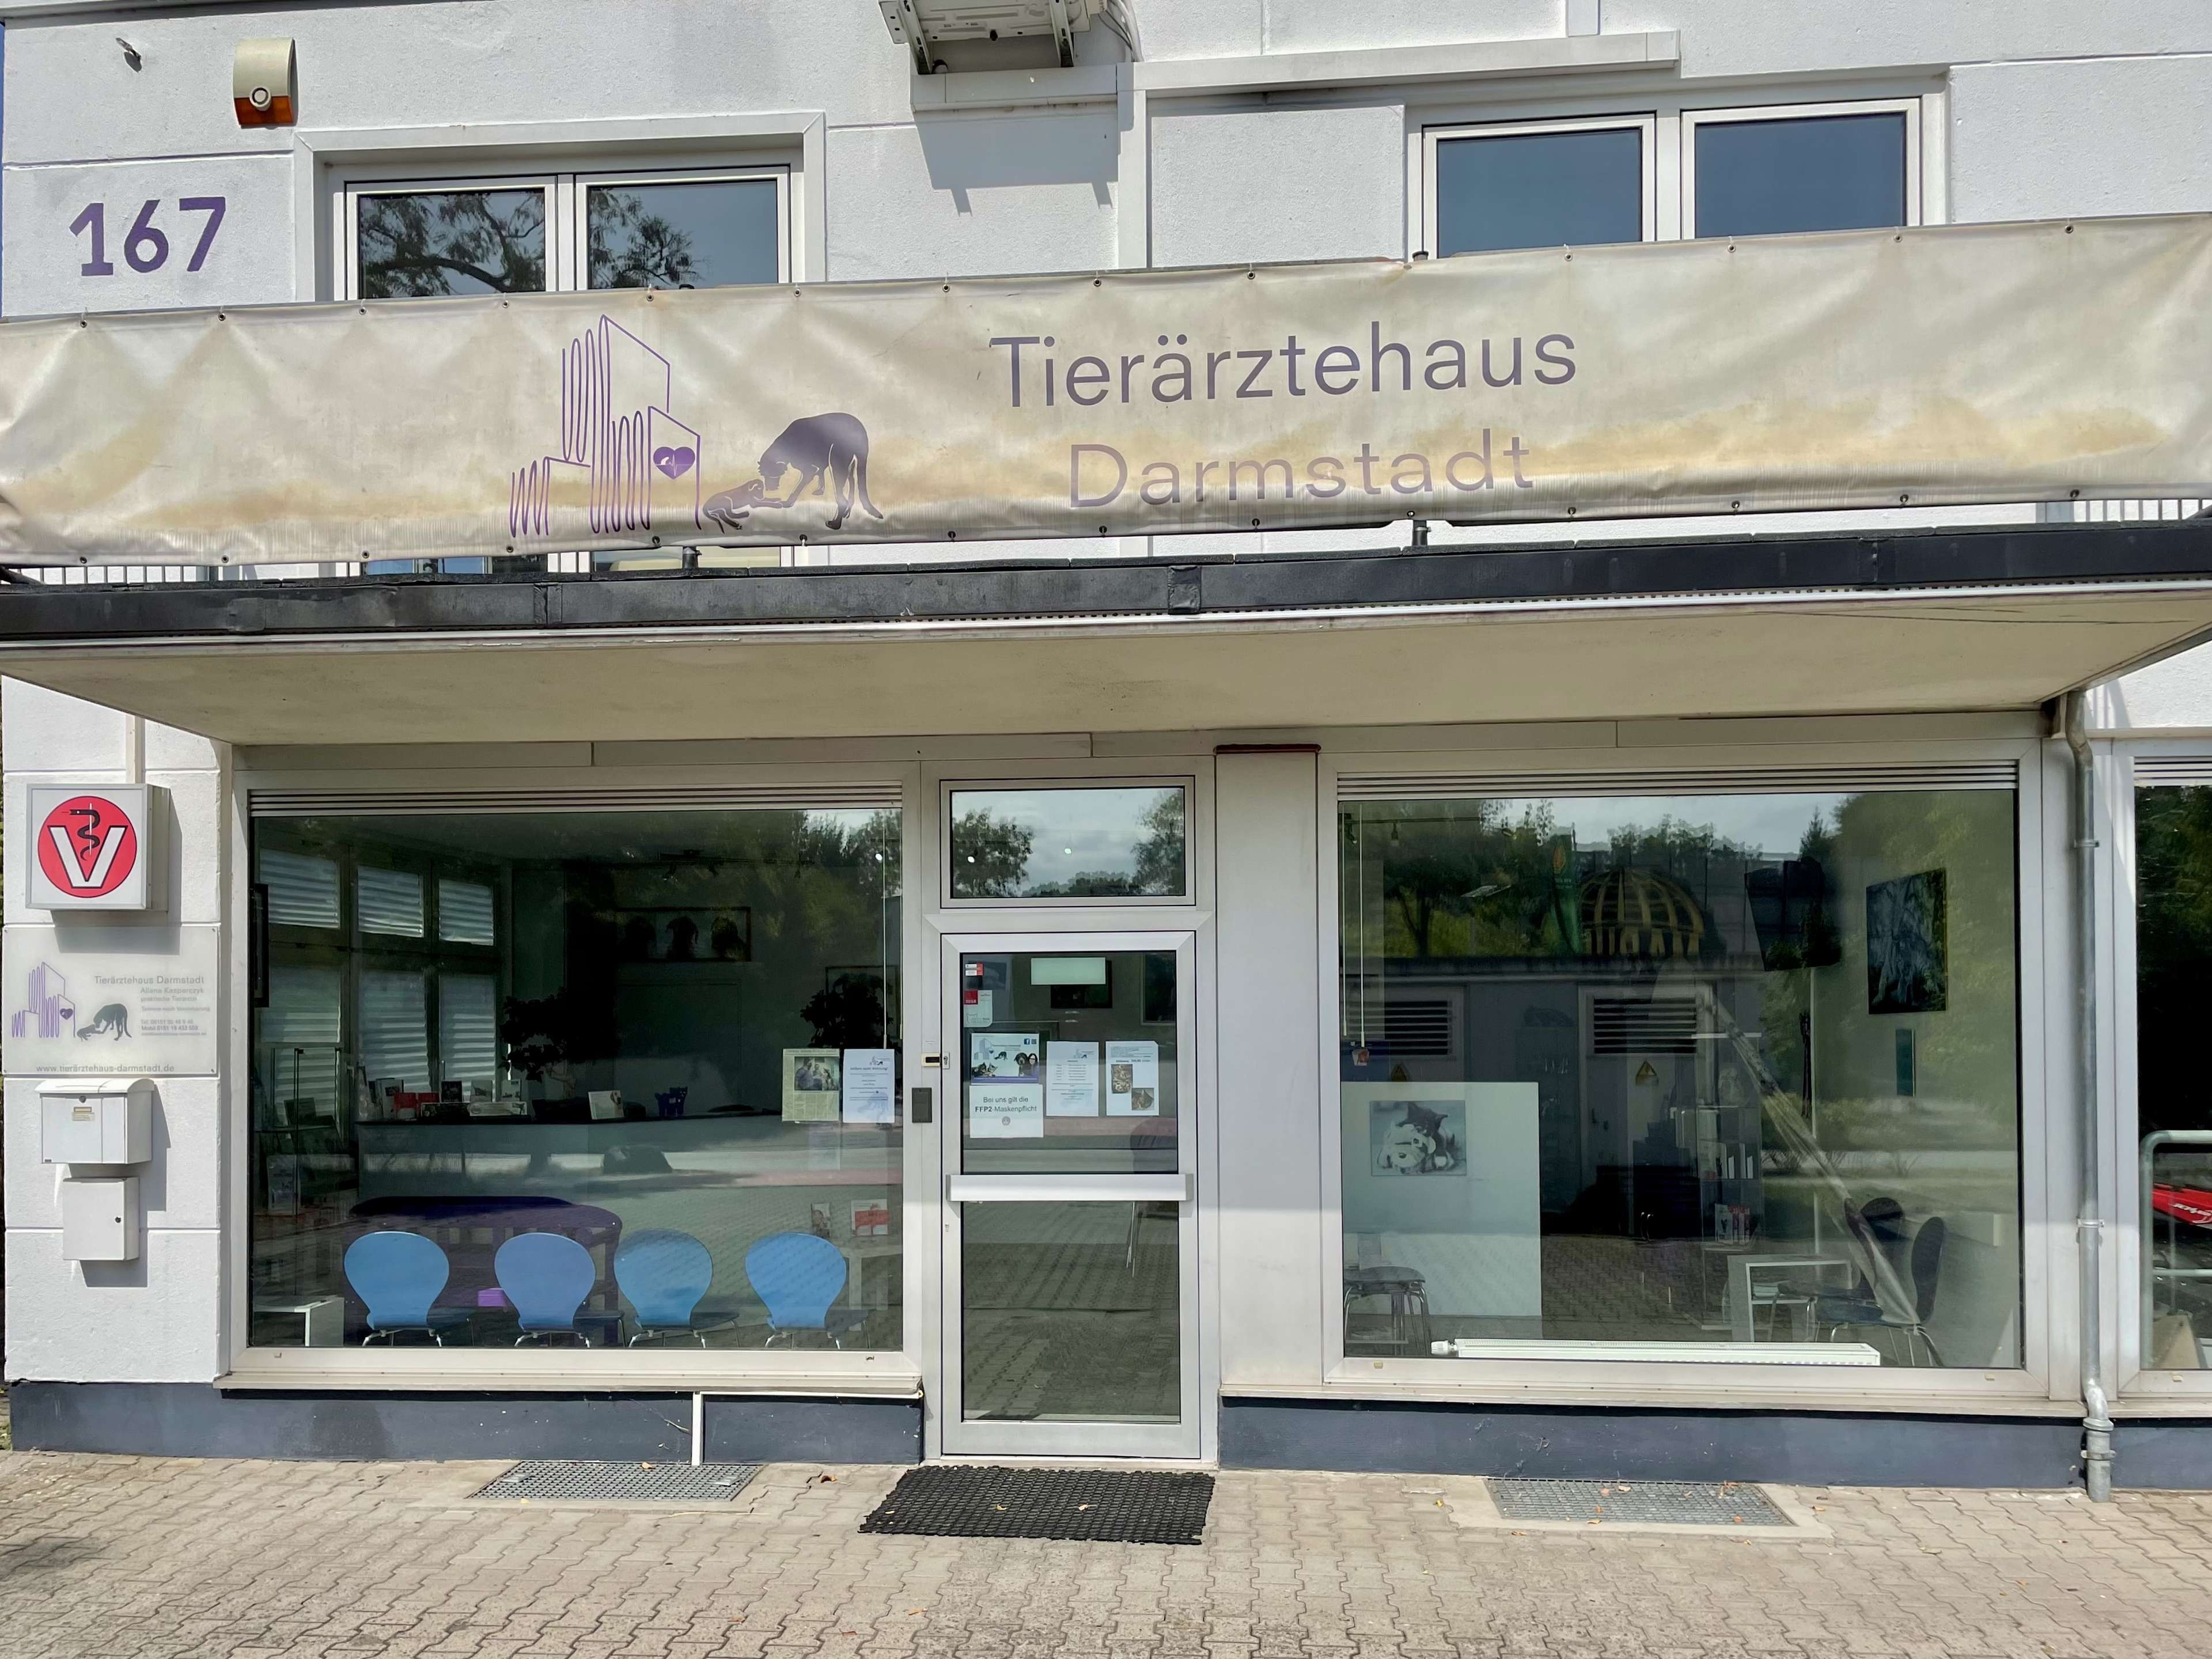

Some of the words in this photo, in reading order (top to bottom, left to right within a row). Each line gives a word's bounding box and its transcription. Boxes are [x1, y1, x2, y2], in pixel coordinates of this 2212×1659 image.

[69, 196, 226, 276] 167
[989, 321, 1576, 408] Tierärztehaus
[1070, 428, 1533, 508] Darmstadt
[47, 825, 128, 889] V
[94, 975, 153, 984] Tierärztehaus
[157, 975, 204, 984] Darmstadt
[36, 1064, 175, 1073] www.tierärztehaus-darmstadt.de
